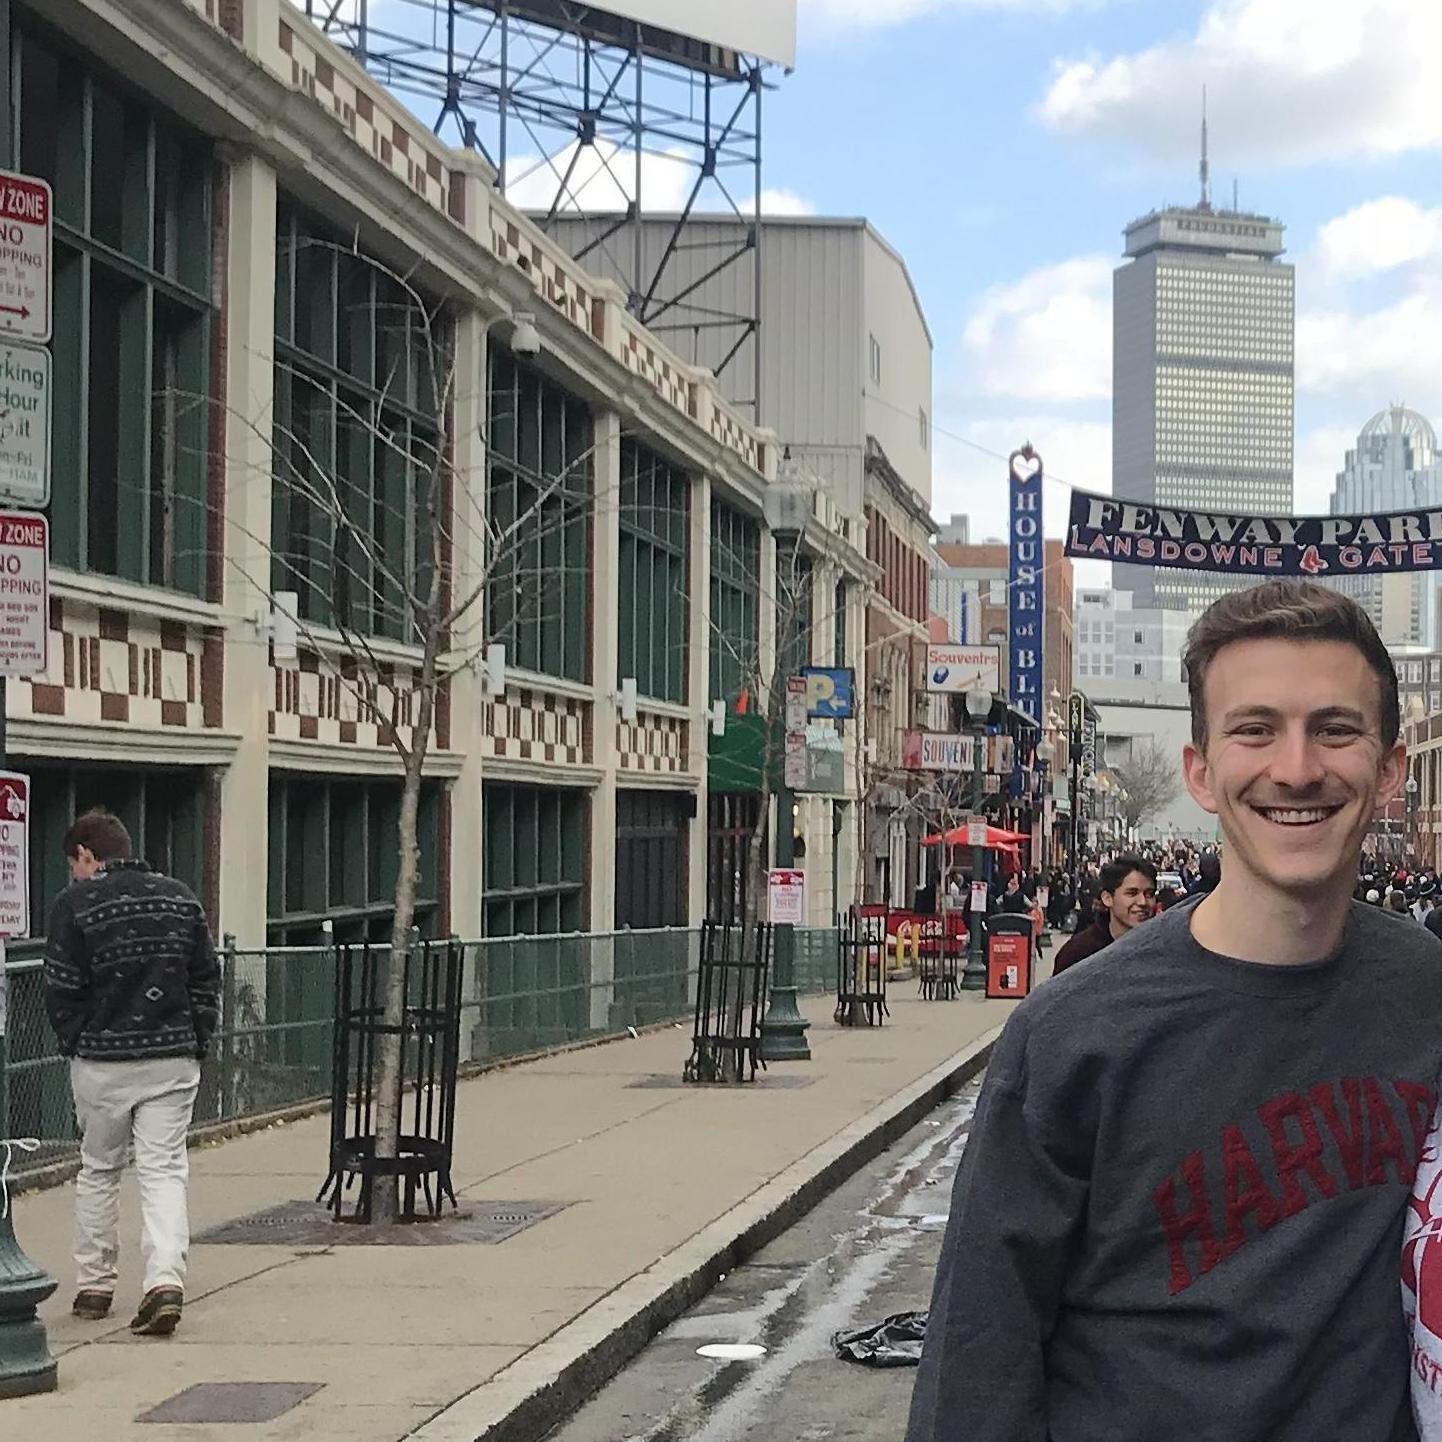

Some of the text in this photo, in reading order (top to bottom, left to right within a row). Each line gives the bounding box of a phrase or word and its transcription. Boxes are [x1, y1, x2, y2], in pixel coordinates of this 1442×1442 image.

[7, 187, 44, 220] ZONE
[0, 246, 42, 268] PPING
[6, 523, 43, 545] ZONE
[1087, 498, 1307, 544] FENWAY
[1015, 493, 1037, 610] HOUSE
[1071, 528, 1284, 567] LANSDOWNE
[1338, 543, 1434, 568] GATE
[1015, 624, 1035, 637] of
[929, 650, 999, 665] Souvenirs
[807, 674, 834, 710] P
